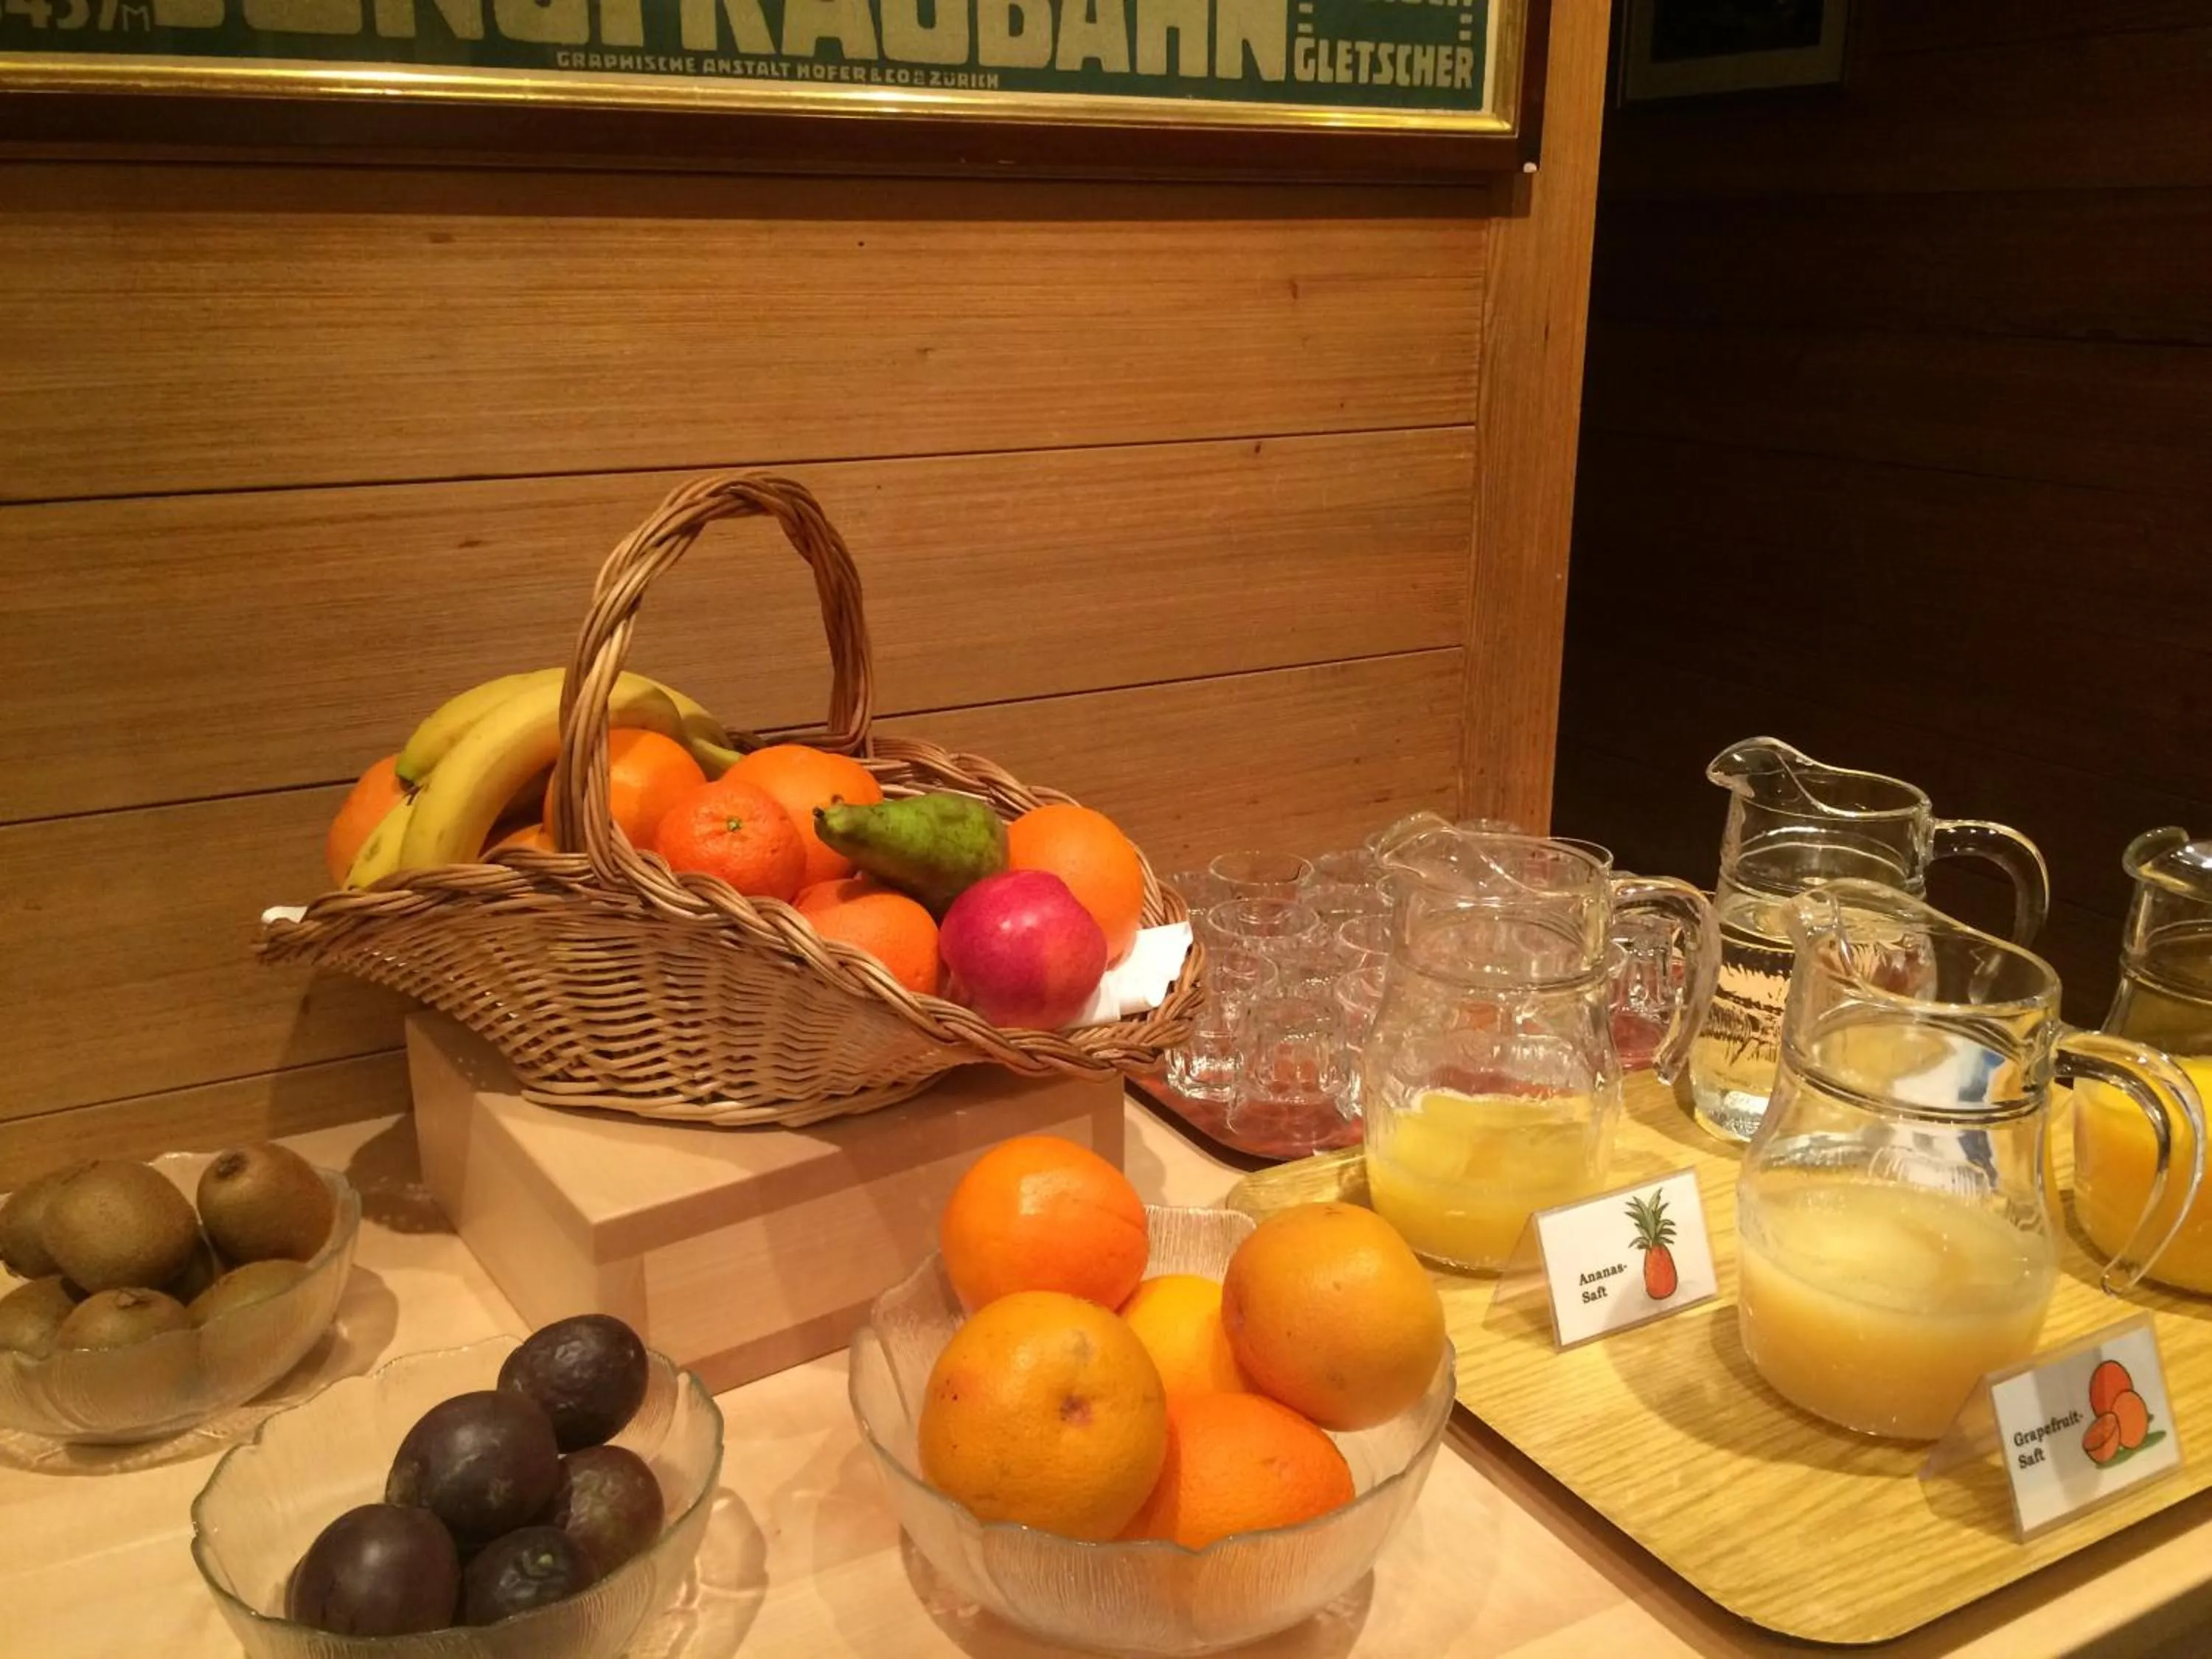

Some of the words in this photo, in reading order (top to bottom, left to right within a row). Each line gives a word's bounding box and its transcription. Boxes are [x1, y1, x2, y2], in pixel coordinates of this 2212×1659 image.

[557, 52, 695, 72] GRAPHISCHE
[703, 58, 791, 77] ANSTALT
[1294, 37, 1473, 88] GLETSCHER
[1579, 1262, 1627, 1286] Ananas-
[1582, 1285, 1608, 1304] Saft
[2013, 1409, 2084, 1447] Grapefruit-
[2017, 1447, 2046, 1470] Saft
